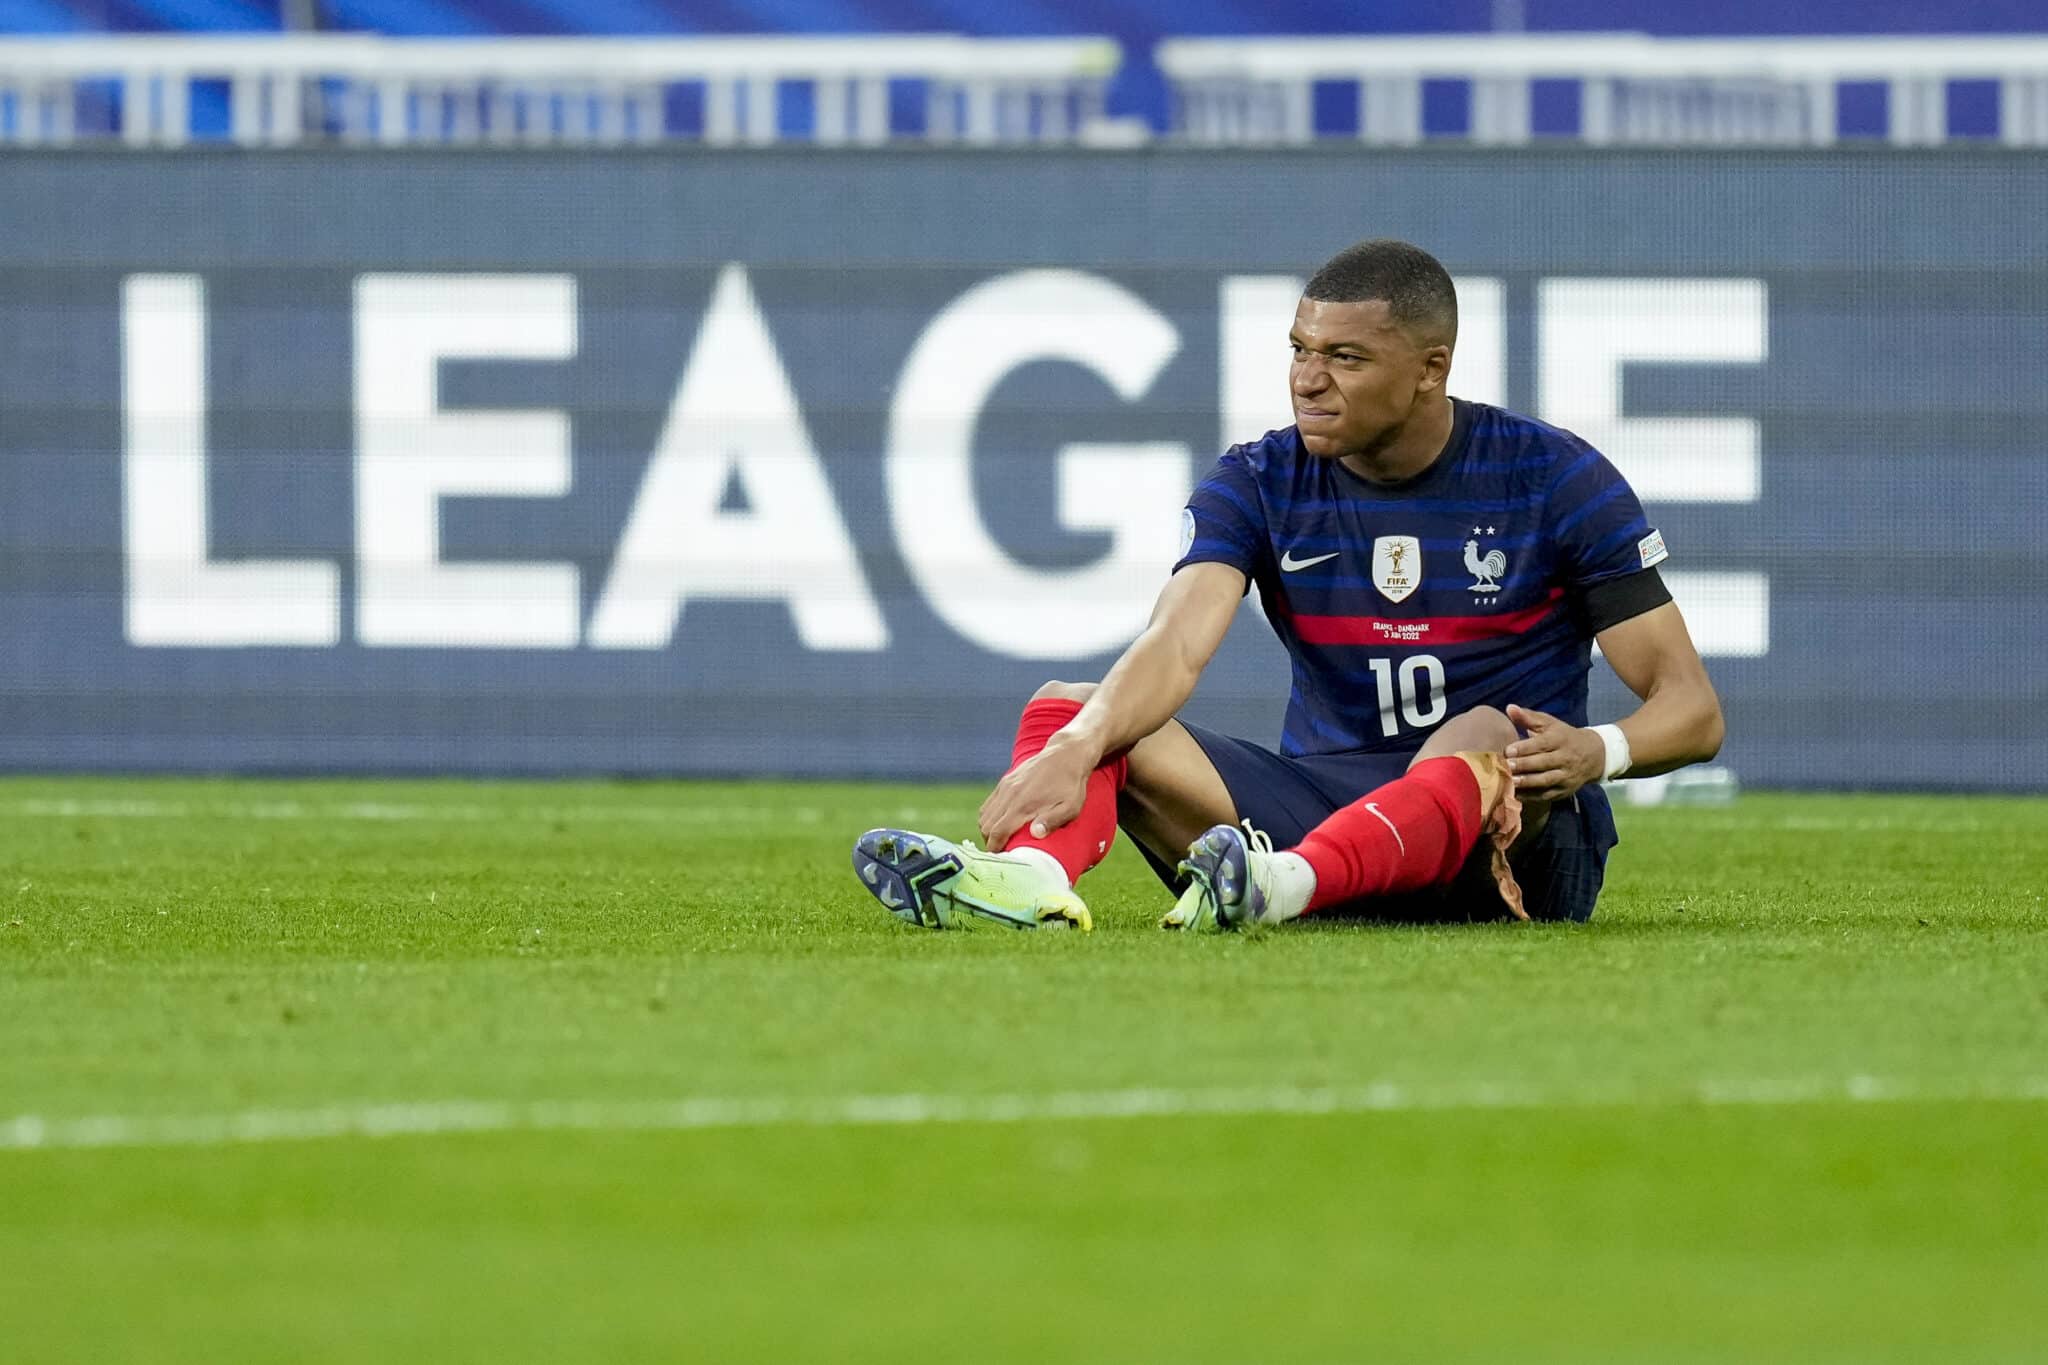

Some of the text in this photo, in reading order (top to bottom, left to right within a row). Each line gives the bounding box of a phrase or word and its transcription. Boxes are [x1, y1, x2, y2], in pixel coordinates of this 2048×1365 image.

[1387, 577, 1408, 585] FIFA
[1384, 630, 1389, 639] 3
[1402, 632, 1420, 640] 2022
[1369, 654, 1447, 737] 10
